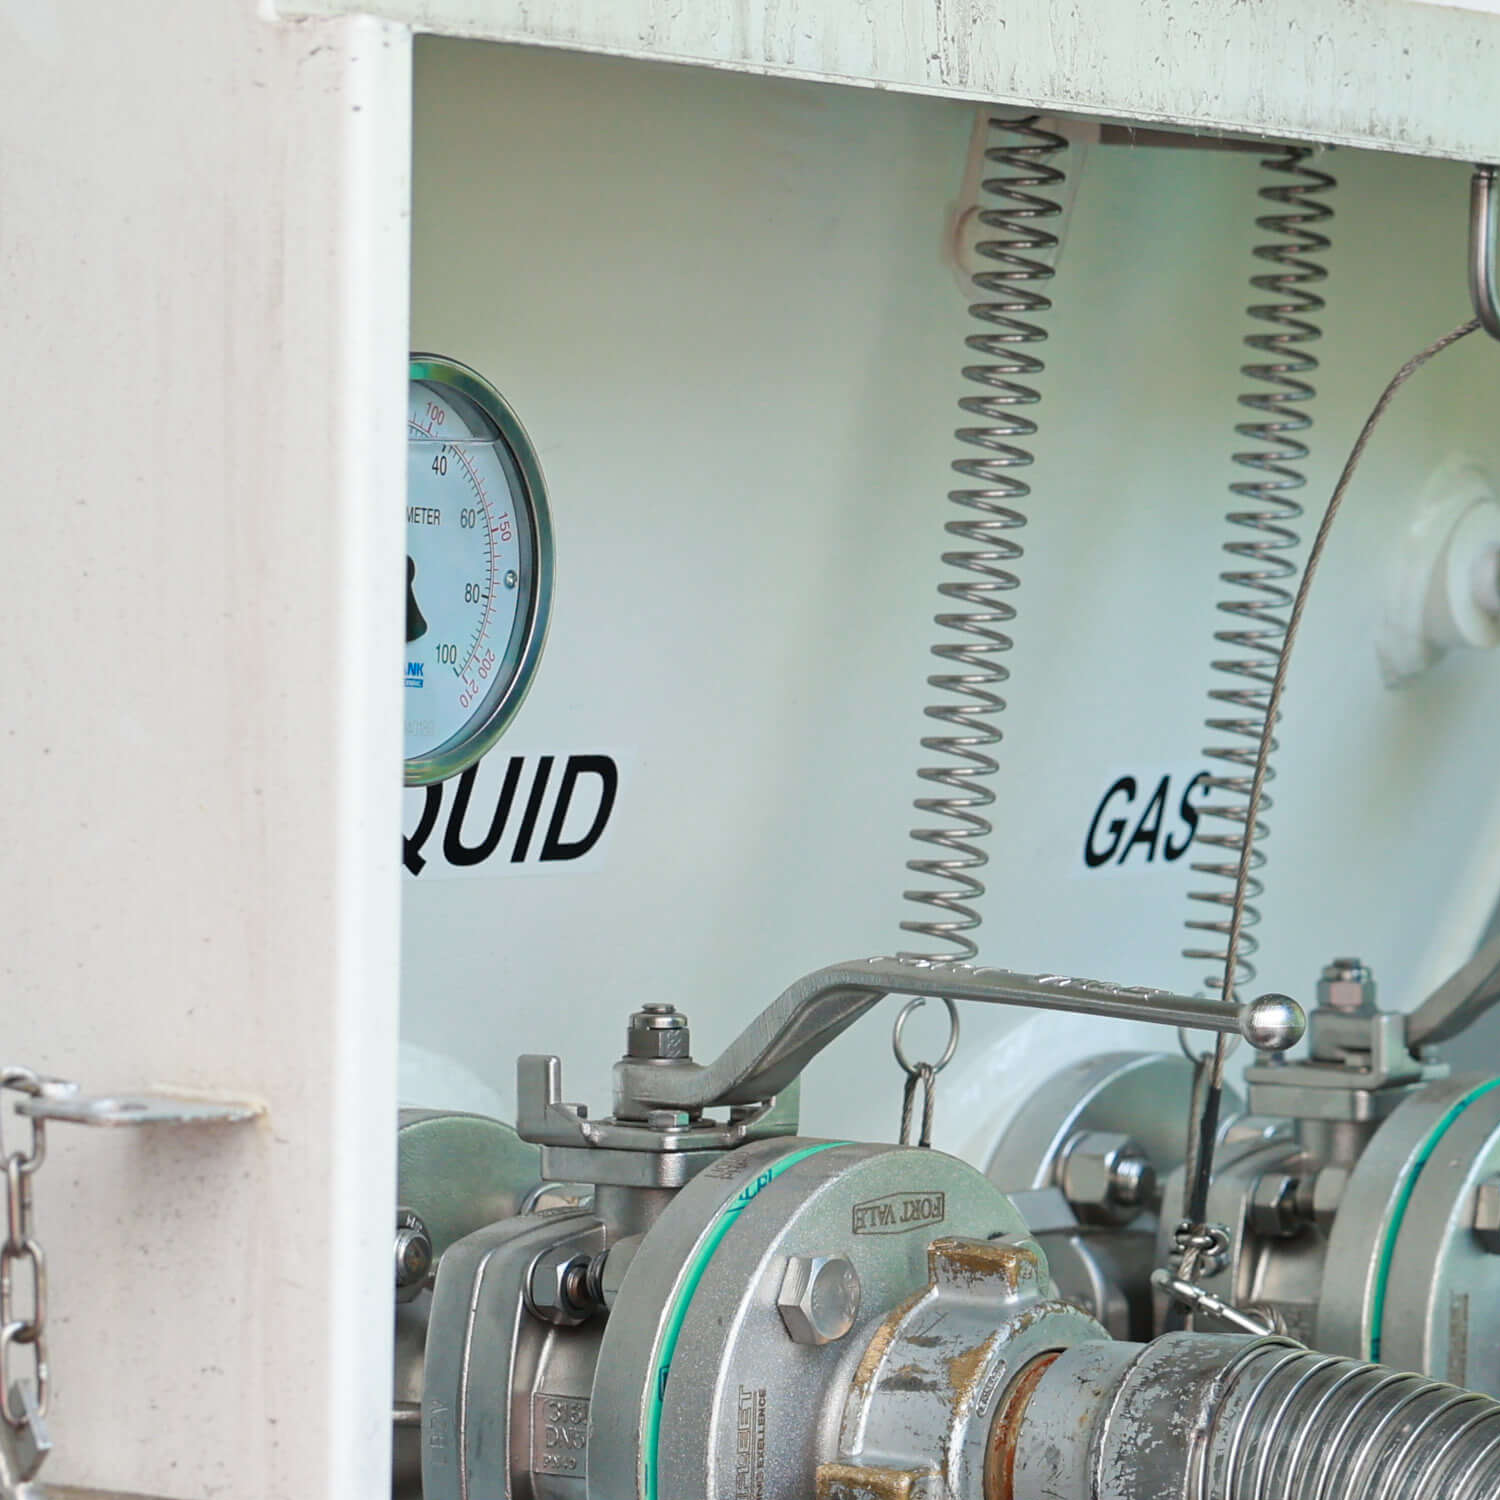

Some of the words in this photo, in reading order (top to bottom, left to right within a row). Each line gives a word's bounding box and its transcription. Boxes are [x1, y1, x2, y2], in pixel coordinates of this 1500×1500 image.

[426, 402, 446, 425] 100
[431, 456, 447, 476] 40
[460, 508, 476, 528] 60
[498, 512, 512, 542] 150
[465, 583, 480, 603] 80
[436, 644, 457, 664] 100
[478, 648, 496, 679] 200
[406, 662, 424, 676] NK
[460, 679, 479, 708] 210
[1085, 771, 1211, 869] GAS
[855, 1203, 897, 1230] VALE
[900, 1196, 942, 1223] FORT
